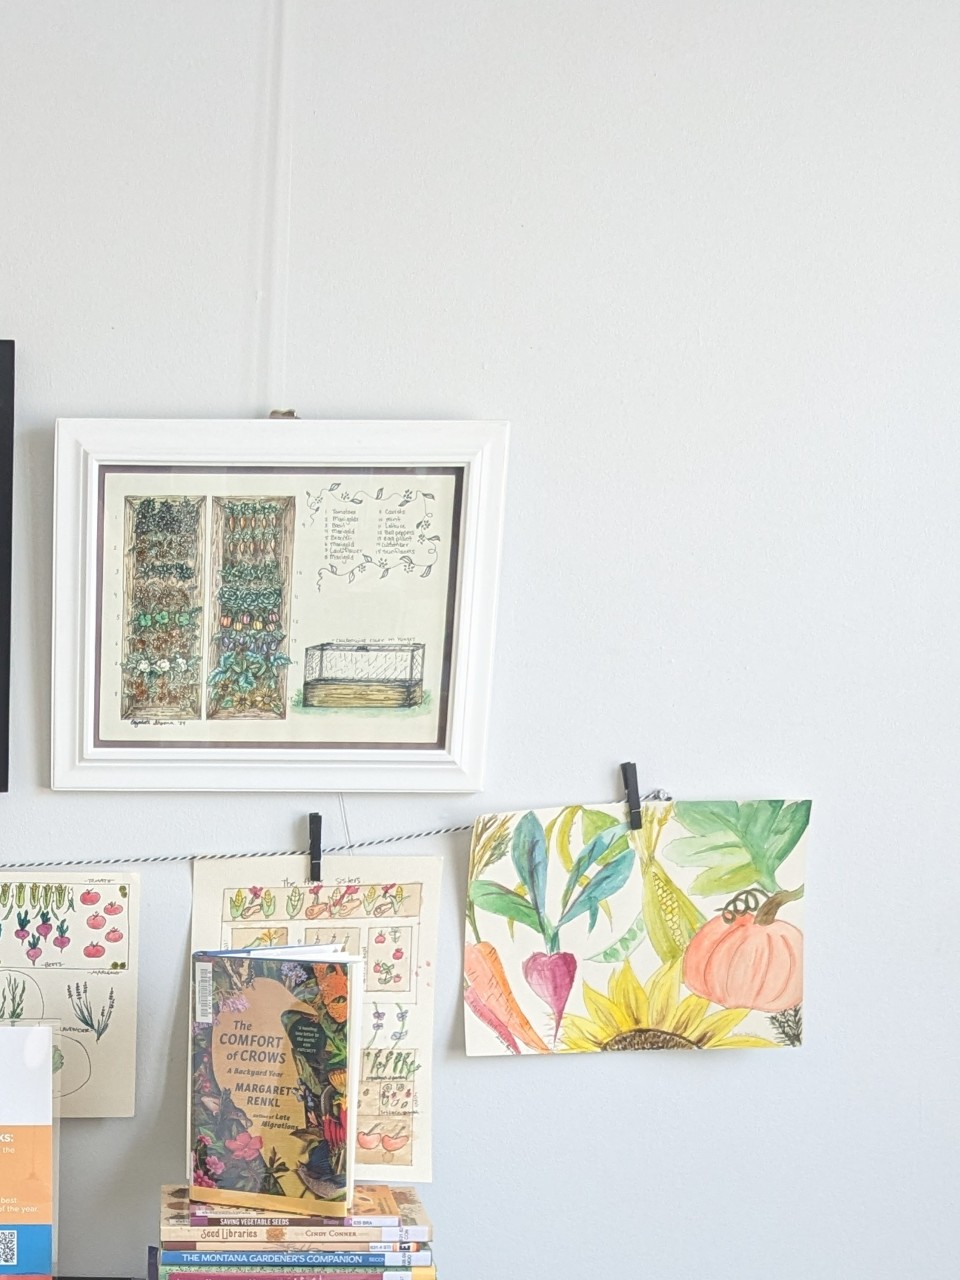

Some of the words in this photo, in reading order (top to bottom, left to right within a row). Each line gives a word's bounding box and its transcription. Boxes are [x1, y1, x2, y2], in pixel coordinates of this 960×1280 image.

[281, 877, 297, 888] The
[233, 1020, 253, 1031] The
[219, 1033, 284, 1049] COMFORT
[226, 1051, 239, 1061] of
[240, 1050, 287, 1064] CROWS
[233, 1067, 268, 1077] Backyard
[268, 1070, 284, 1078] Year
[234, 1082, 292, 1097] MARGARET
[246, 1096, 281, 1108] RENKL
[275, 1113, 291, 1121] Late
[260, 1120, 299, 1130] Migrations
[200, 1228, 220, 1239] Seed
[221, 1228, 258, 1240] Libraries
[182, 1253, 200, 1262] THE
[201, 1254, 248, 1262] MONTANA
[249, 1254, 305, 1263] GARDENER'S
[308, 1255, 363, 1263] COMPANION
